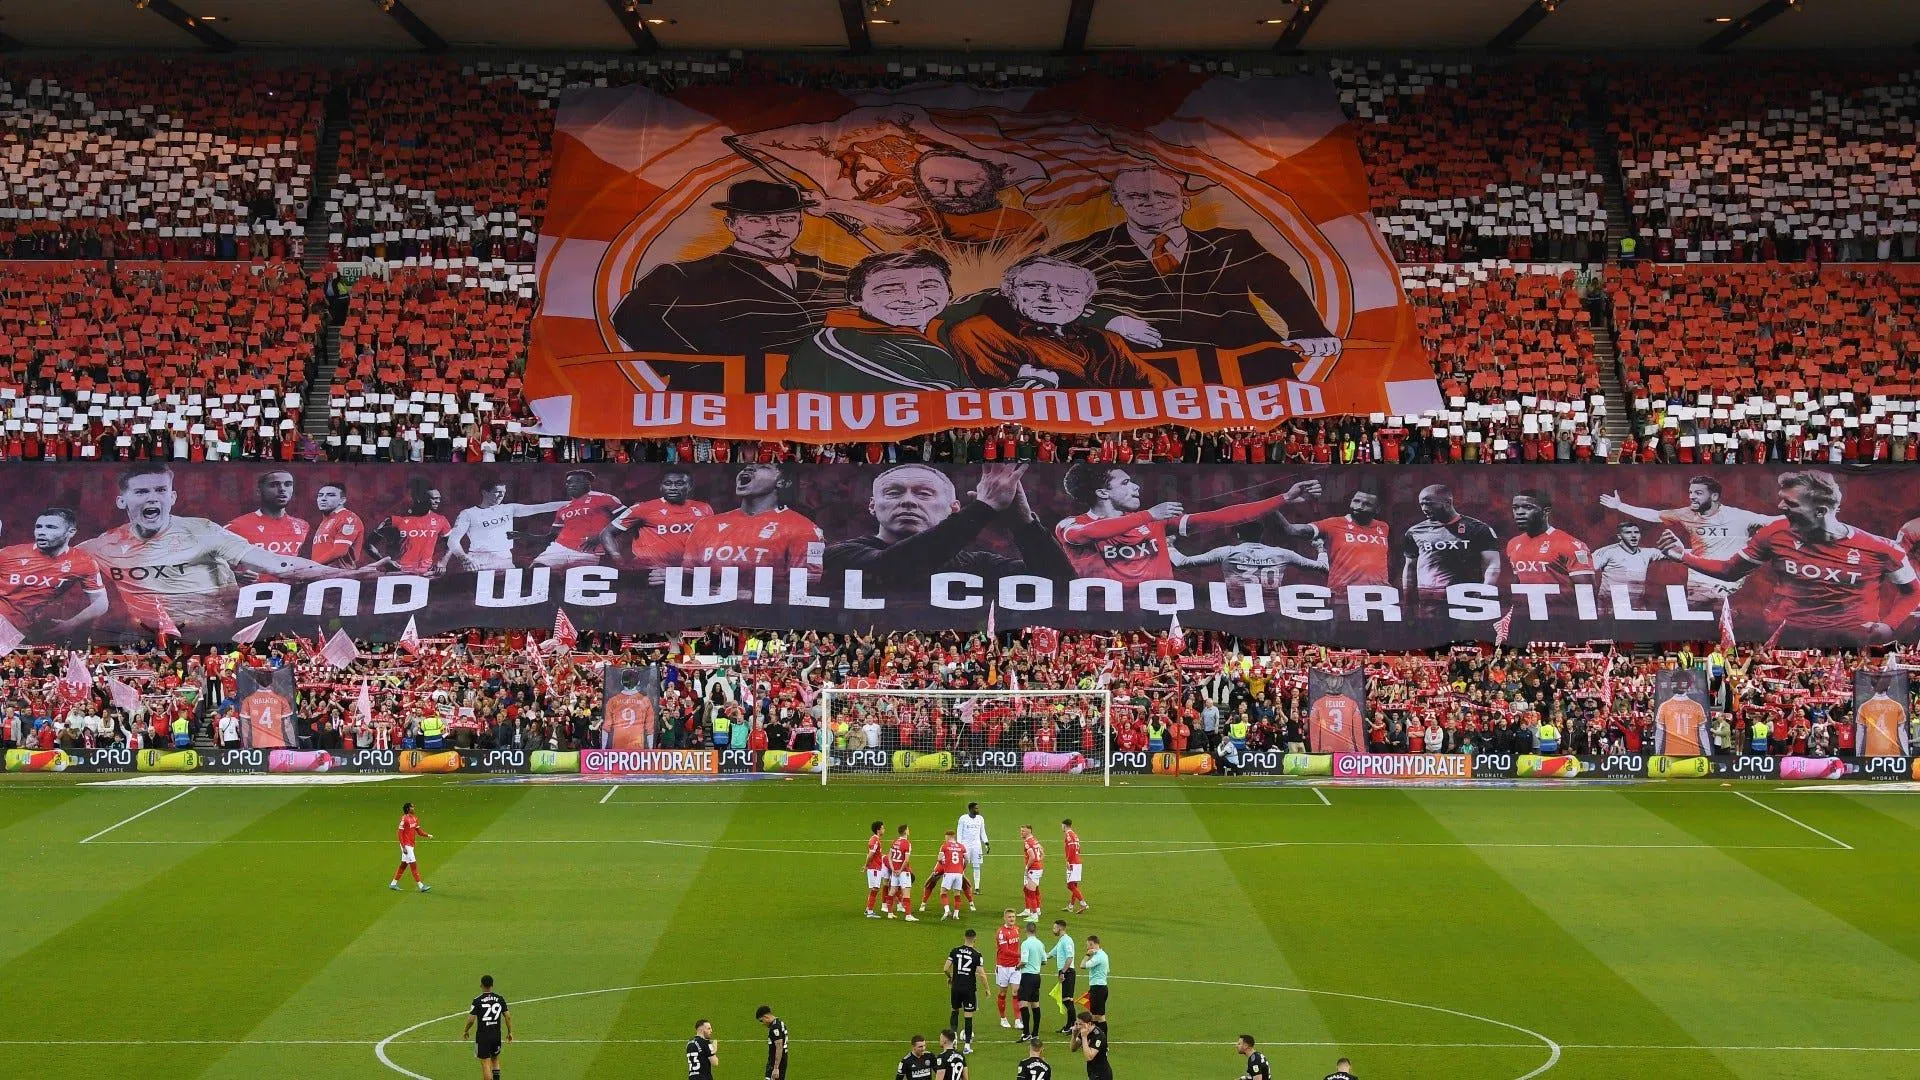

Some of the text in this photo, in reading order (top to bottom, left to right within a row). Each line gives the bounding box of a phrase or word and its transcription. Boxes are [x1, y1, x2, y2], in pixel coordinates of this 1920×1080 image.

[343, 267, 362, 276] EXIT
[632, 381, 1326, 431] WE HAVE CONQUERED
[482, 514, 510, 528] BOXT
[399, 529, 437, 538] BOXT
[1345, 532, 1388, 546] BOXT
[703, 545, 769, 563] BOXT
[1103, 538, 1158, 559] BOXT
[1423, 540, 1471, 551] BOXT
[9, 573, 68, 588] BOXT
[110, 562, 189, 581] BOXT
[1785, 559, 1862, 585] BOXT
[235, 565, 1714, 621] AND WE WILL CONQUER STILL
[717, 656, 738, 665] EXIT
[259, 706, 273, 729] 4
[621, 707, 636, 729] 9
[1328, 708, 1343, 732] 3
[585, 750, 712, 771] @iPROHYDRATE
[1338, 755, 1466, 775] @iPROHYDRATE
[891, 848, 903, 862] 22
[951, 851, 960, 865] 8
[956, 953, 973, 972] 12
[481, 1003, 502, 1021] 29
